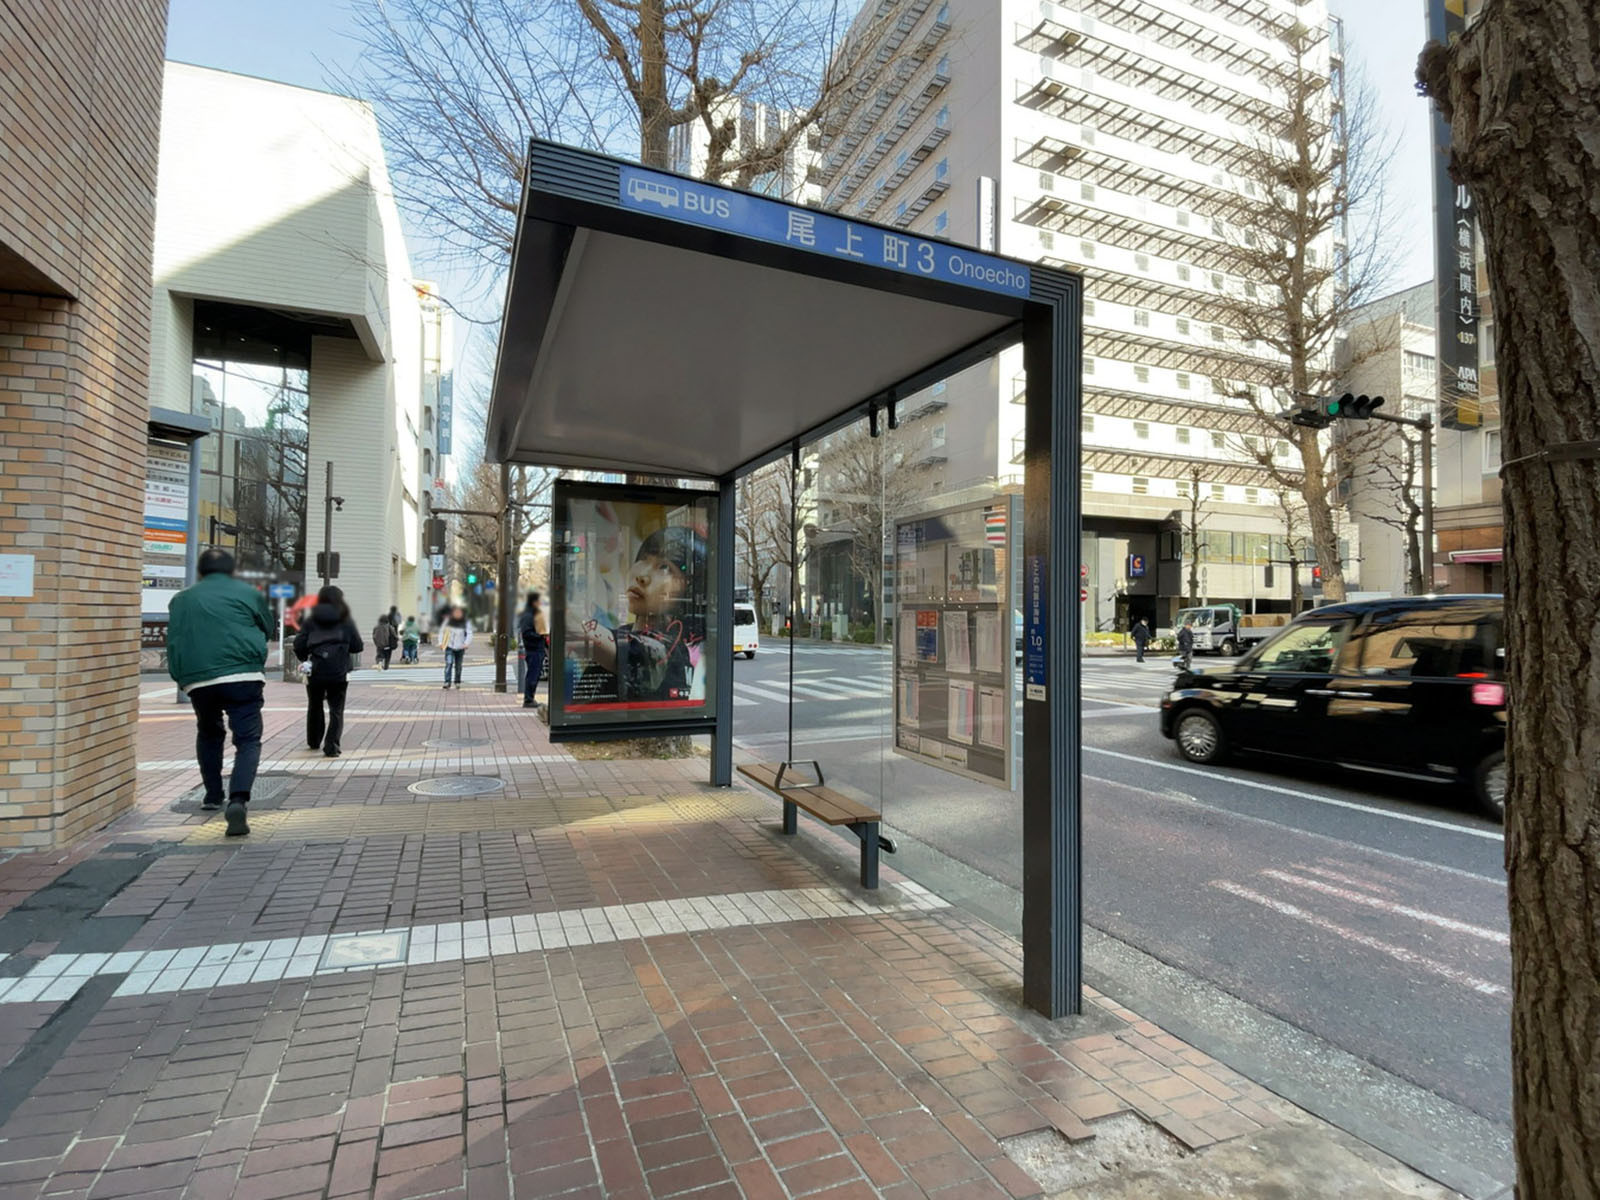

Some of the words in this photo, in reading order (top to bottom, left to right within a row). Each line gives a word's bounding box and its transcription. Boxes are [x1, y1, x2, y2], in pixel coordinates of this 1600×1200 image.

[684, 191, 730, 218] BUS
[948, 255, 1026, 290] Onoecho
[1458, 366, 1477, 382] APA
